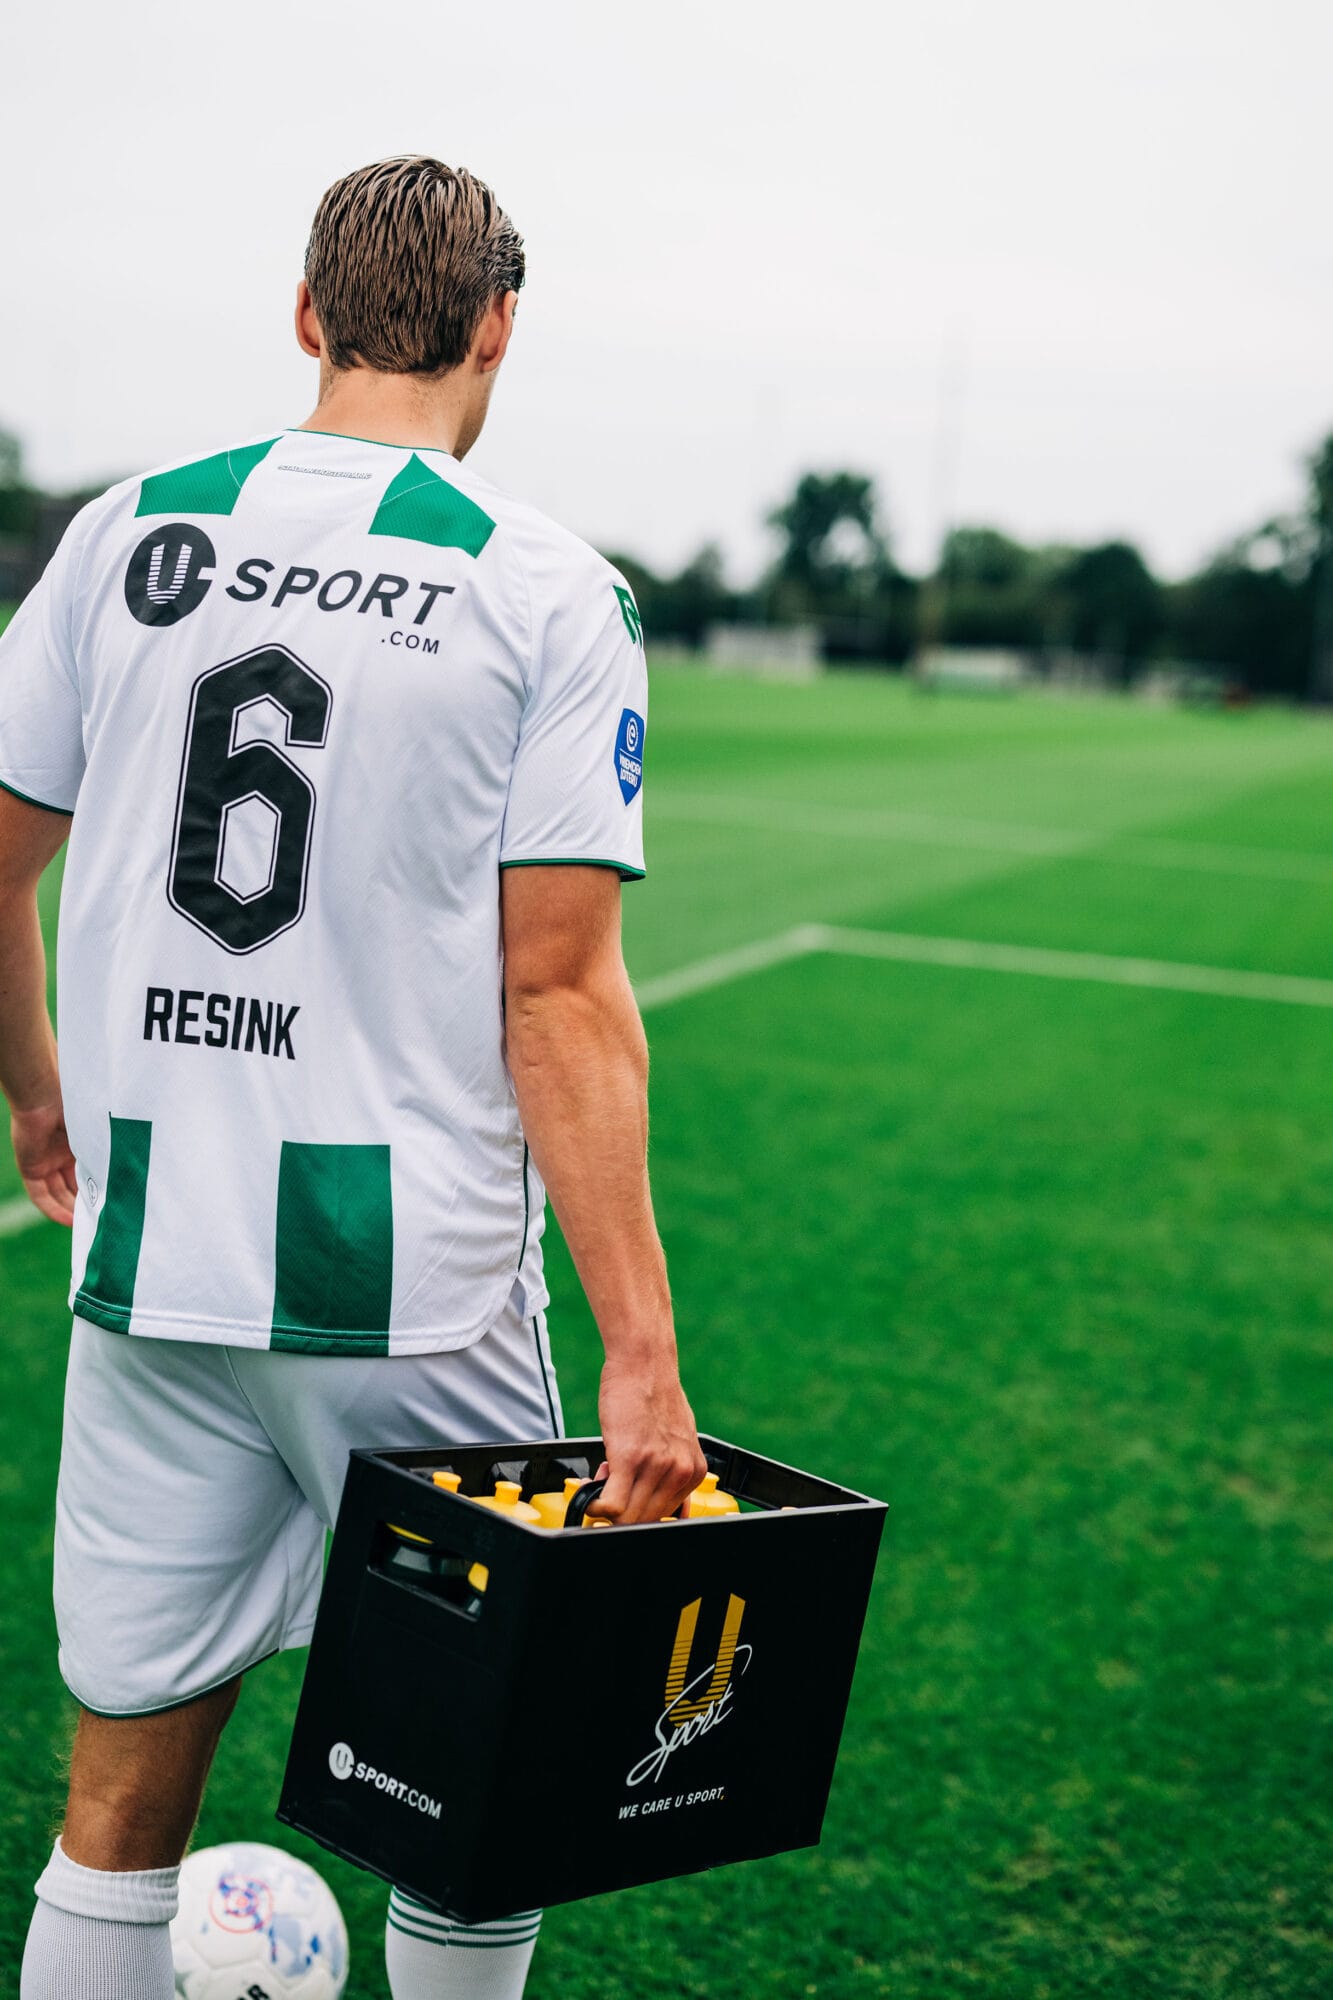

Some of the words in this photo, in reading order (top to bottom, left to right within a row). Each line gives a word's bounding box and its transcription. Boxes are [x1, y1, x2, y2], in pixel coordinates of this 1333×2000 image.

[225, 558, 456, 625] SPORT
[381, 631, 440, 654] .COM
[166, 643, 333, 956] 6
[143, 987, 300, 1060] RESINK
[625, 1643, 753, 1787] Sport
[354, 1762, 442, 1819] SPORT.COM
[618, 1804, 639, 1820] WE
[641, 1797, 672, 1815] CARE
[674, 1794, 684, 1808] U
